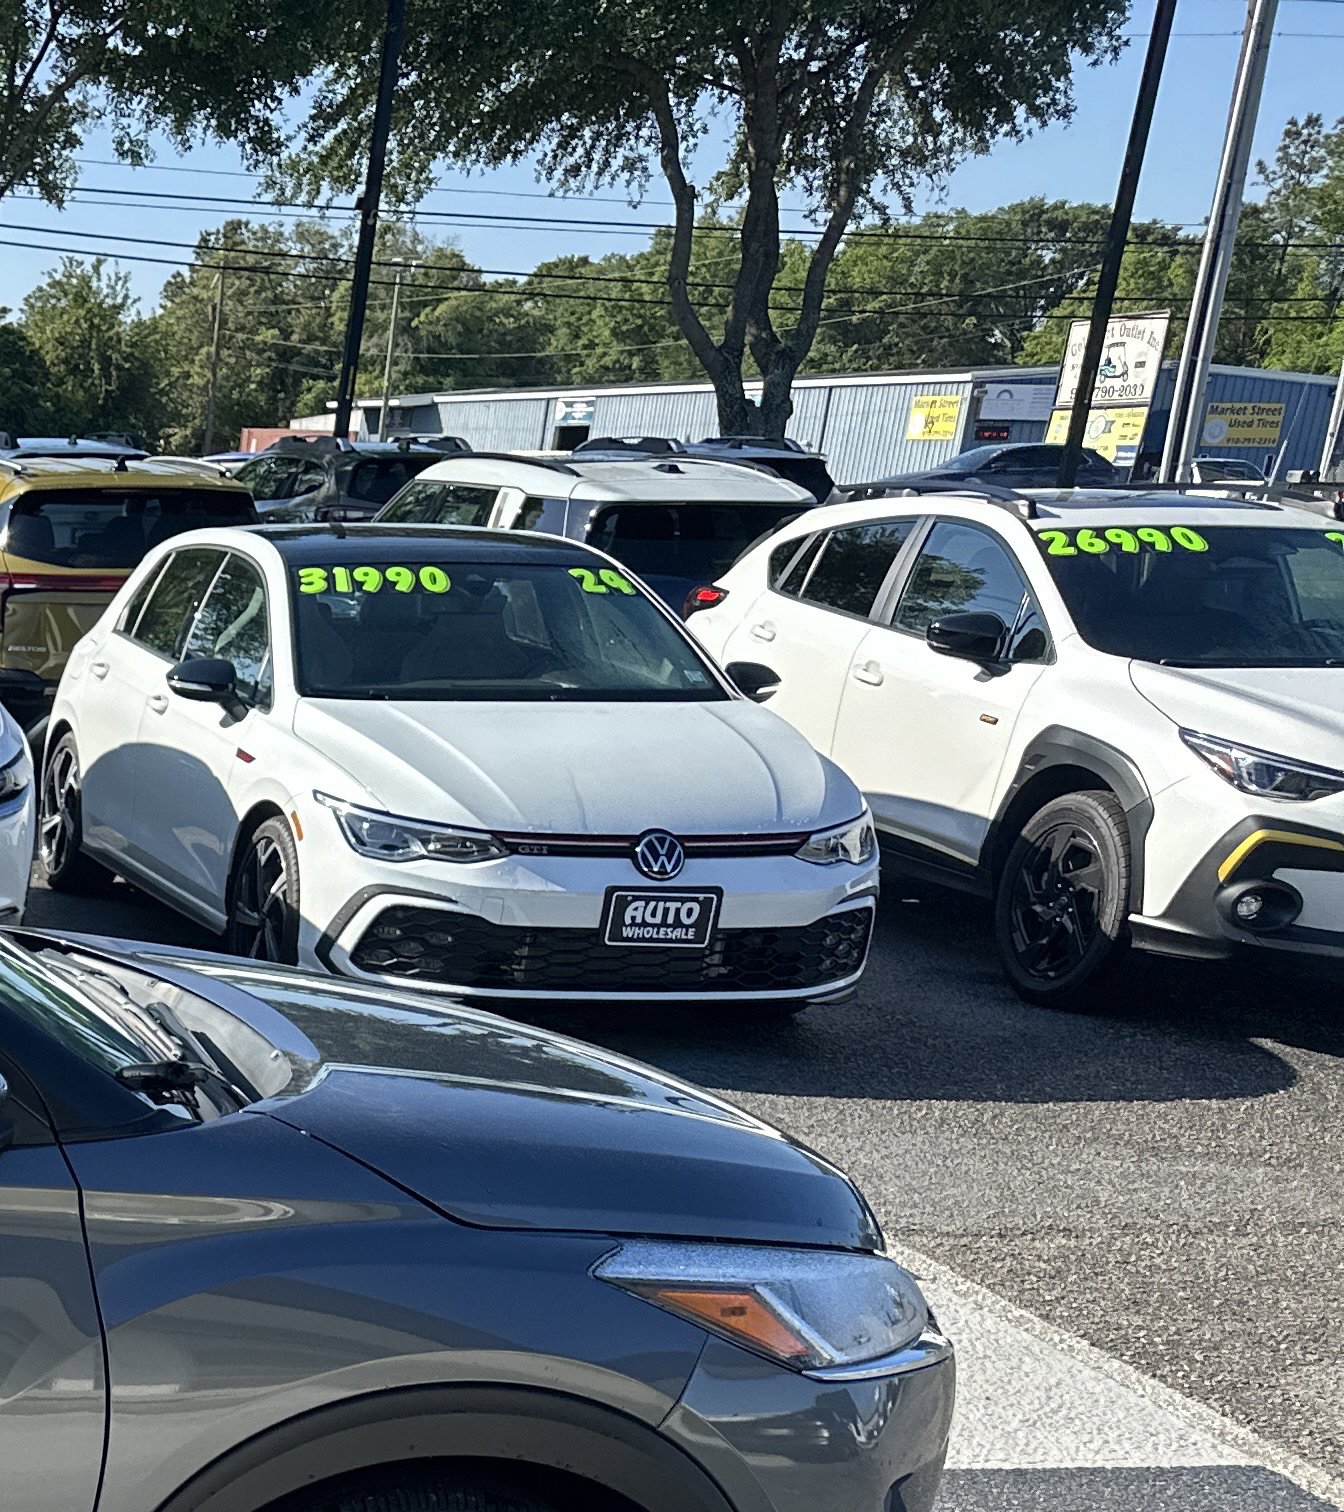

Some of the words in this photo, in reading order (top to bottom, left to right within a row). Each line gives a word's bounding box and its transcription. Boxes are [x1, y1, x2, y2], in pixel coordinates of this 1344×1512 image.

[1209, 404, 1248, 417] Market
[1249, 404, 1283, 417] Street
[1228, 418, 1254, 429] Used
[1256, 419, 1280, 429] Tires
[1038, 526, 1209, 556] 26990
[298, 566, 450, 594] 31990
[518, 845, 549, 855] GTI
[624, 900, 701, 925] AUTO
[622, 926, 696, 940] WHOLESALE
